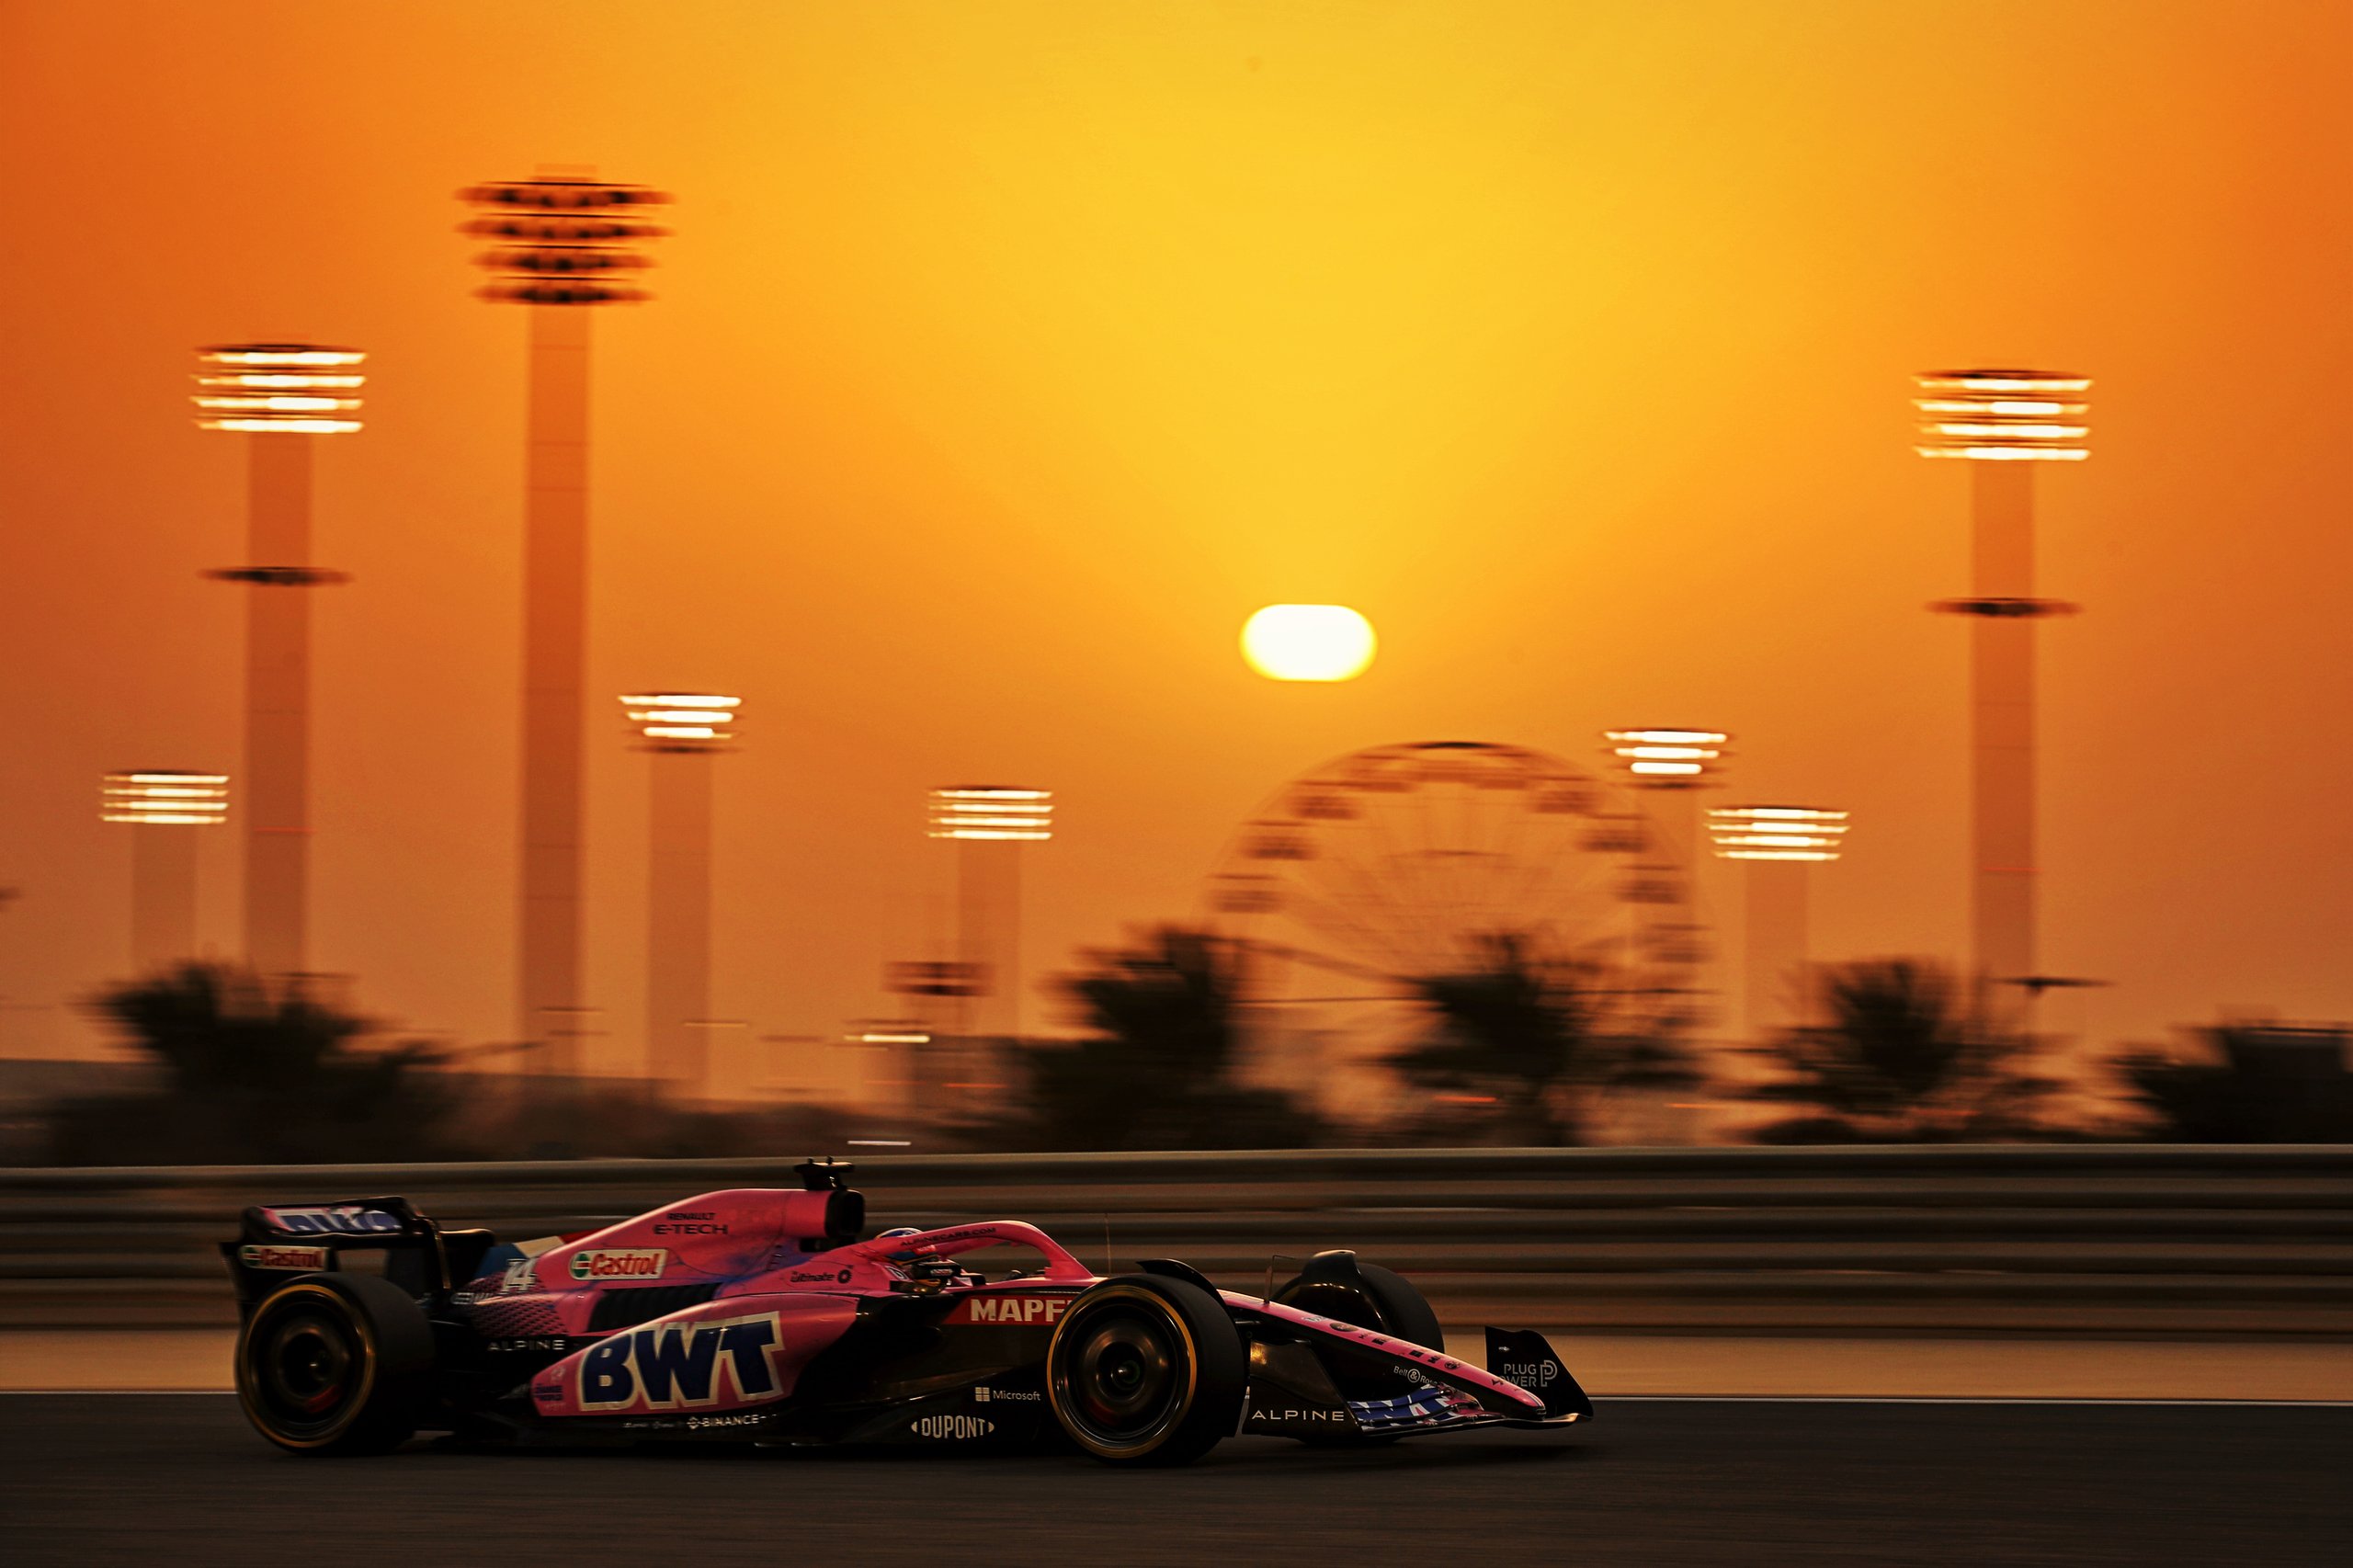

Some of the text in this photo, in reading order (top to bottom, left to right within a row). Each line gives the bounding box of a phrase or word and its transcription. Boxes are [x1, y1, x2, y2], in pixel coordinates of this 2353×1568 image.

[667, 1212, 716, 1221] RENAULT
[654, 1223, 729, 1235] E-TECH
[901, 1227, 997, 1247] ALPINECARS.COM
[261, 1247, 324, 1268] Castrol
[591, 1253, 661, 1277] Castrol
[970, 1298, 1073, 1323] MAPF
[486, 1339, 566, 1352] ALPINE
[580, 1312, 783, 1409] BWT
[1393, 1365, 1408, 1377] Bell
[1503, 1362, 1537, 1376] PLUG
[993, 1389, 1041, 1402] Microsoft
[701, 1414, 760, 1427] BINANCE
[1251, 1409, 1345, 1422] ALPINE
[921, 1415, 986, 1439] DUPONT
